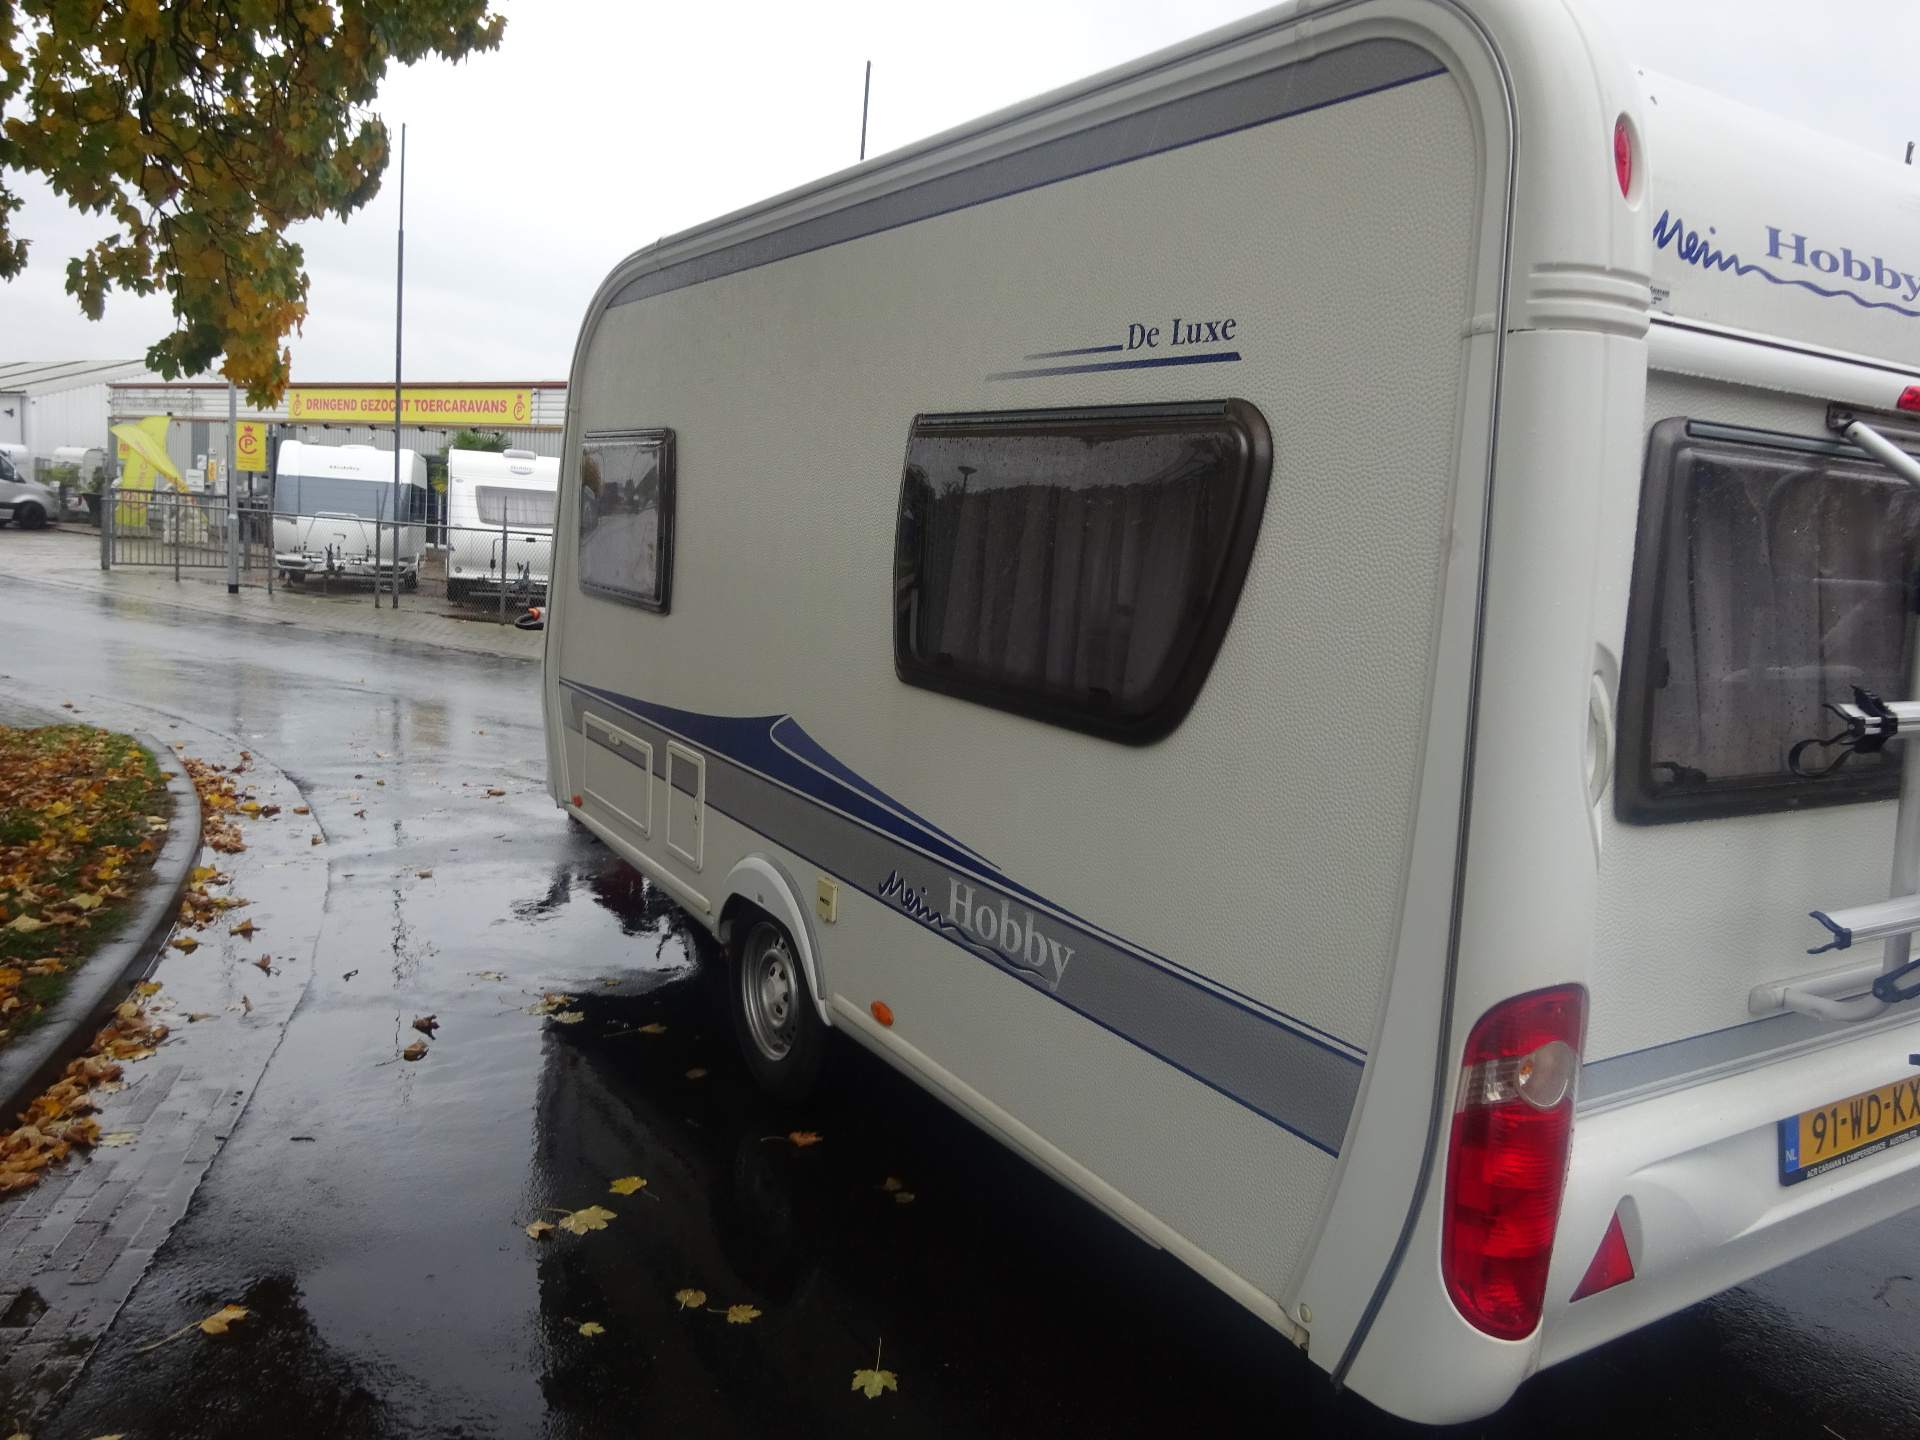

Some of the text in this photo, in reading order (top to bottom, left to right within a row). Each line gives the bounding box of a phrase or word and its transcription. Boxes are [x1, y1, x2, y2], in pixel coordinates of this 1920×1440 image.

[1653, 209, 1920, 301] Mein Hobby
[1126, 317, 1238, 350] De Luxe
[306, 398, 357, 411] DRINGEND
[413, 399, 507, 414] TOERCARAVANS
[878, 870, 1077, 993] Mein Hobby
[1811, 1078, 1920, 1155] 91-WD-KX
[1785, 1148, 1797, 1163] NL
[1818, 1159, 1842, 1174] CARAVAN
[1846, 1141, 1887, 1163] CAMPERSERVICE
